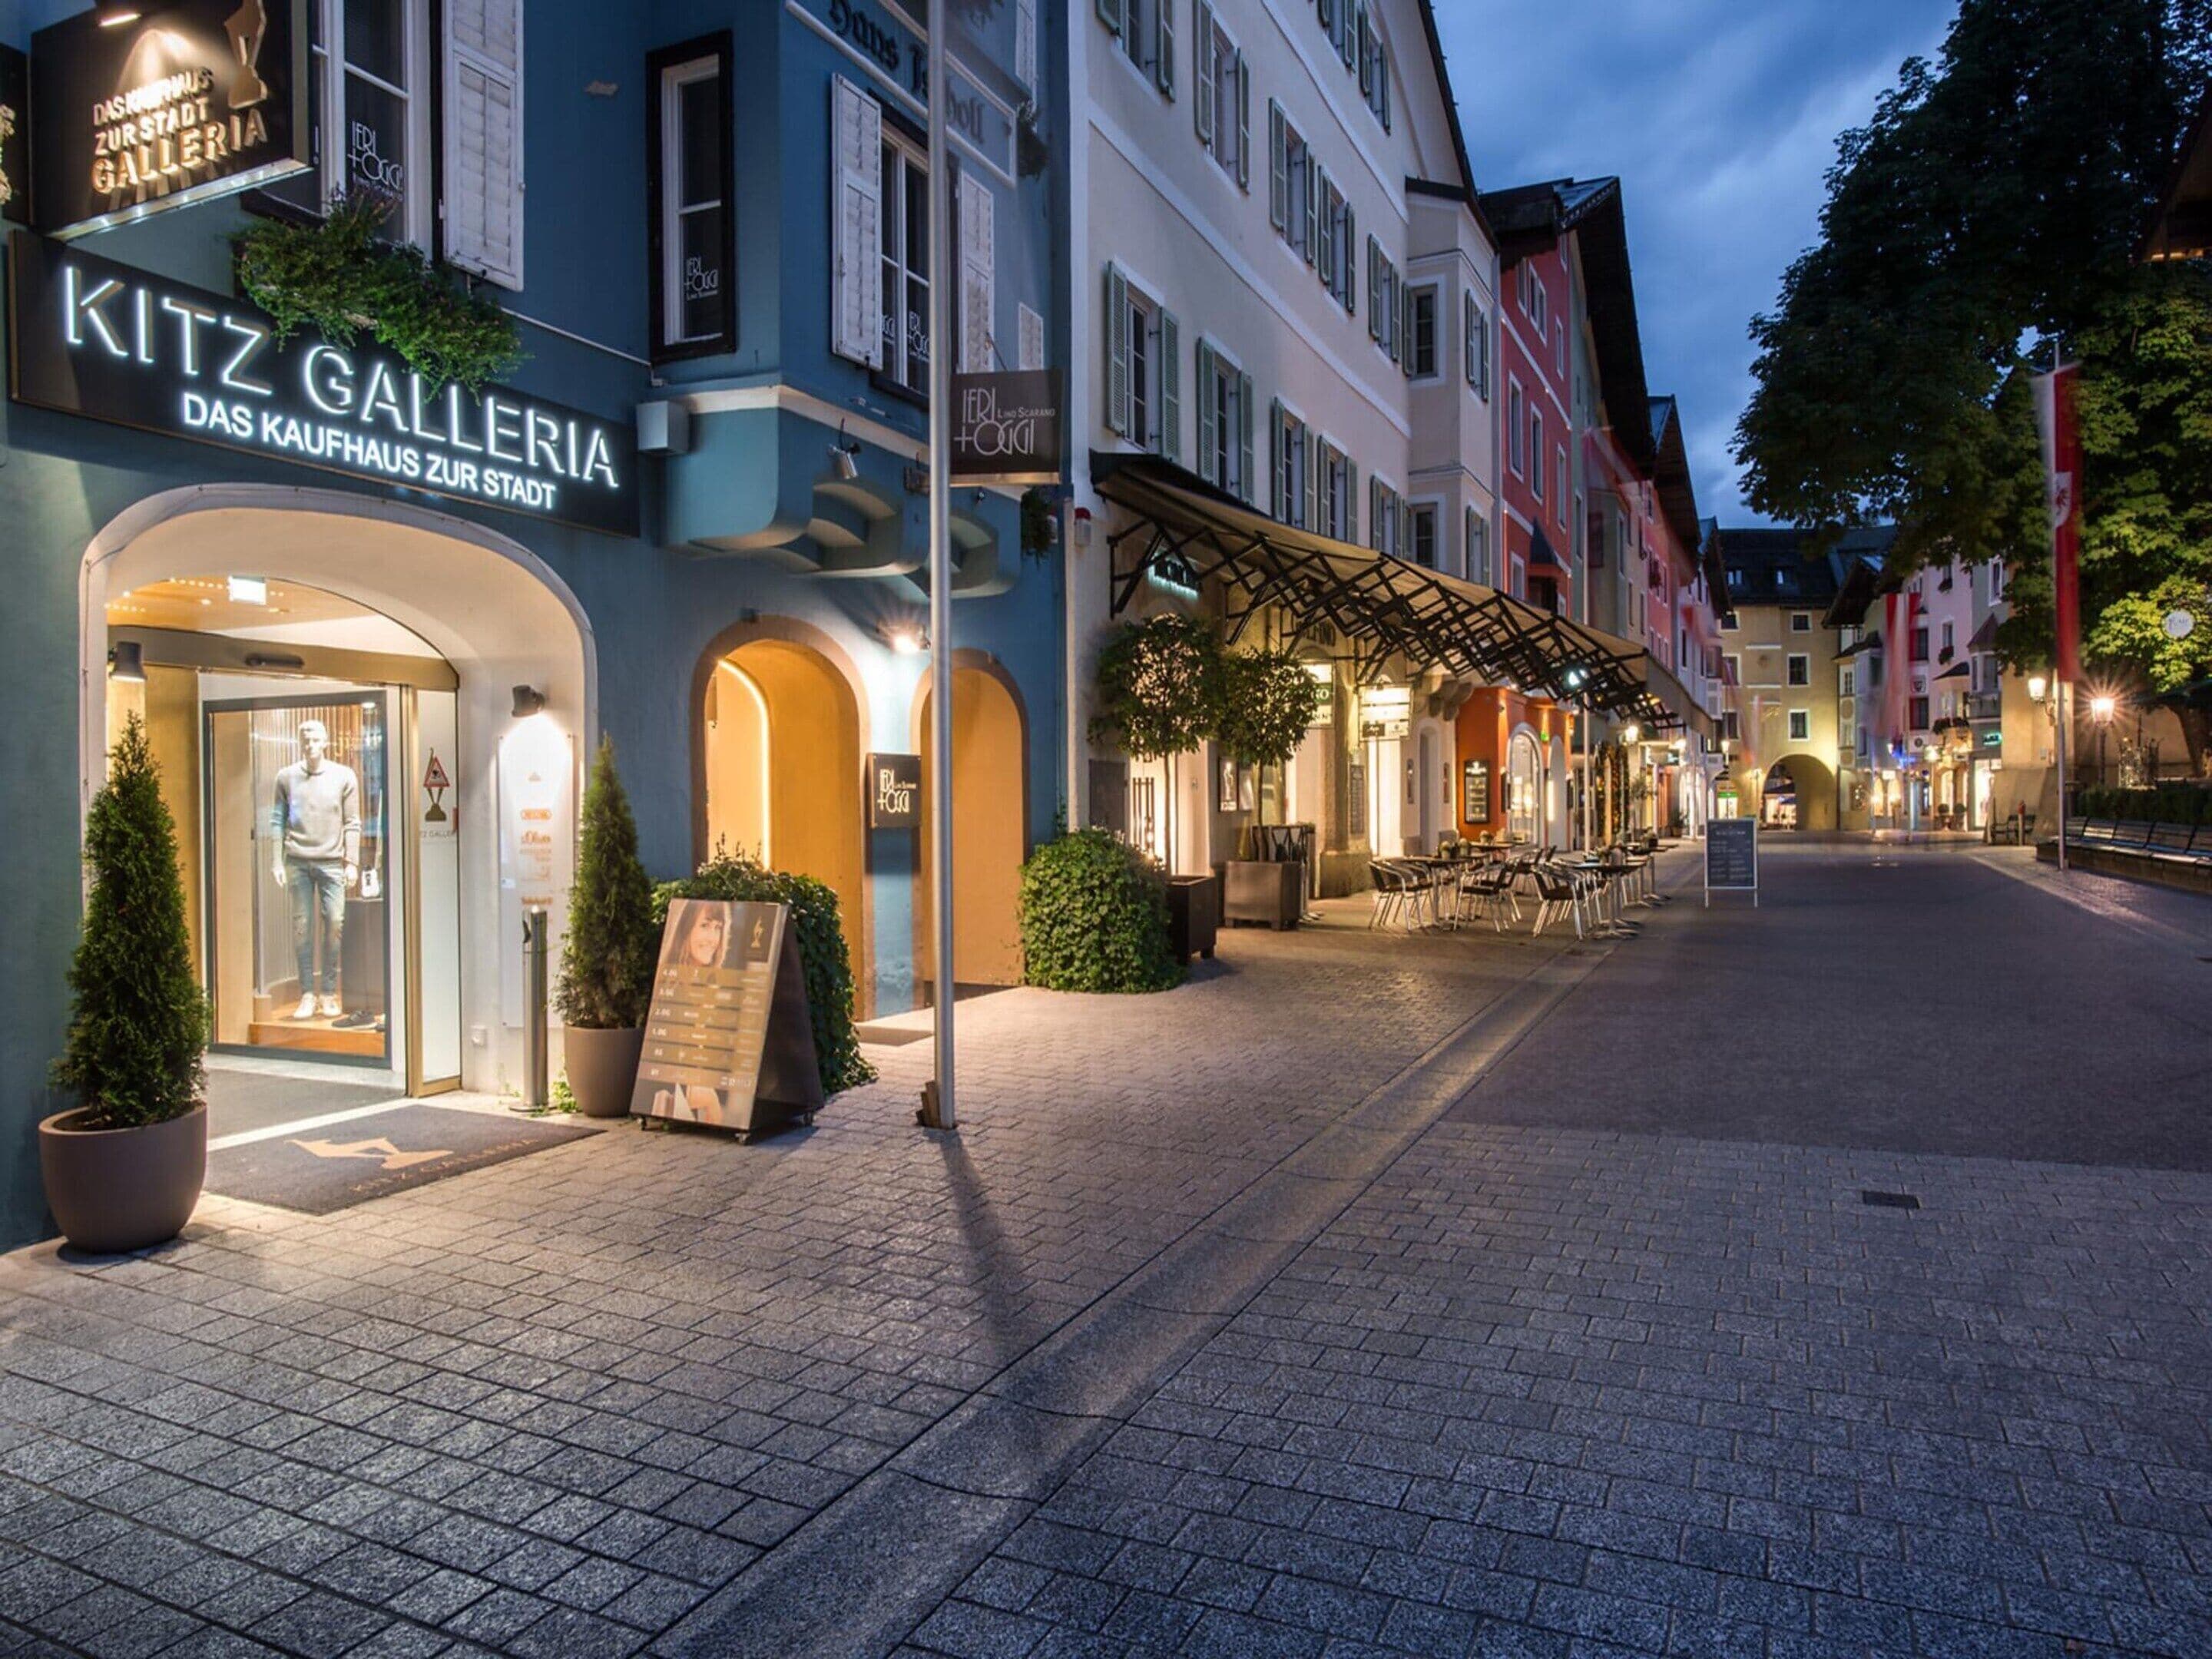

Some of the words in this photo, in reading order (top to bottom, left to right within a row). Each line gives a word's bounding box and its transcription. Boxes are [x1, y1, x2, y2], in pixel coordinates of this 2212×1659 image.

[92, 95, 126, 126] DAS
[124, 68, 214, 115] KHAUS
[95, 122, 139, 155] ZUR
[138, 96, 209, 143] STADT
[91, 108, 268, 194] GALLERIA
[65, 266, 273, 396] KITZ
[303, 344, 621, 488] GALLERIA
[962, 386, 996, 424] IERI
[182, 392, 253, 438] DAS
[260, 411, 421, 478] KAUFHAUS
[426, 452, 479, 493] ZUR
[482, 469, 557, 510] STADT
